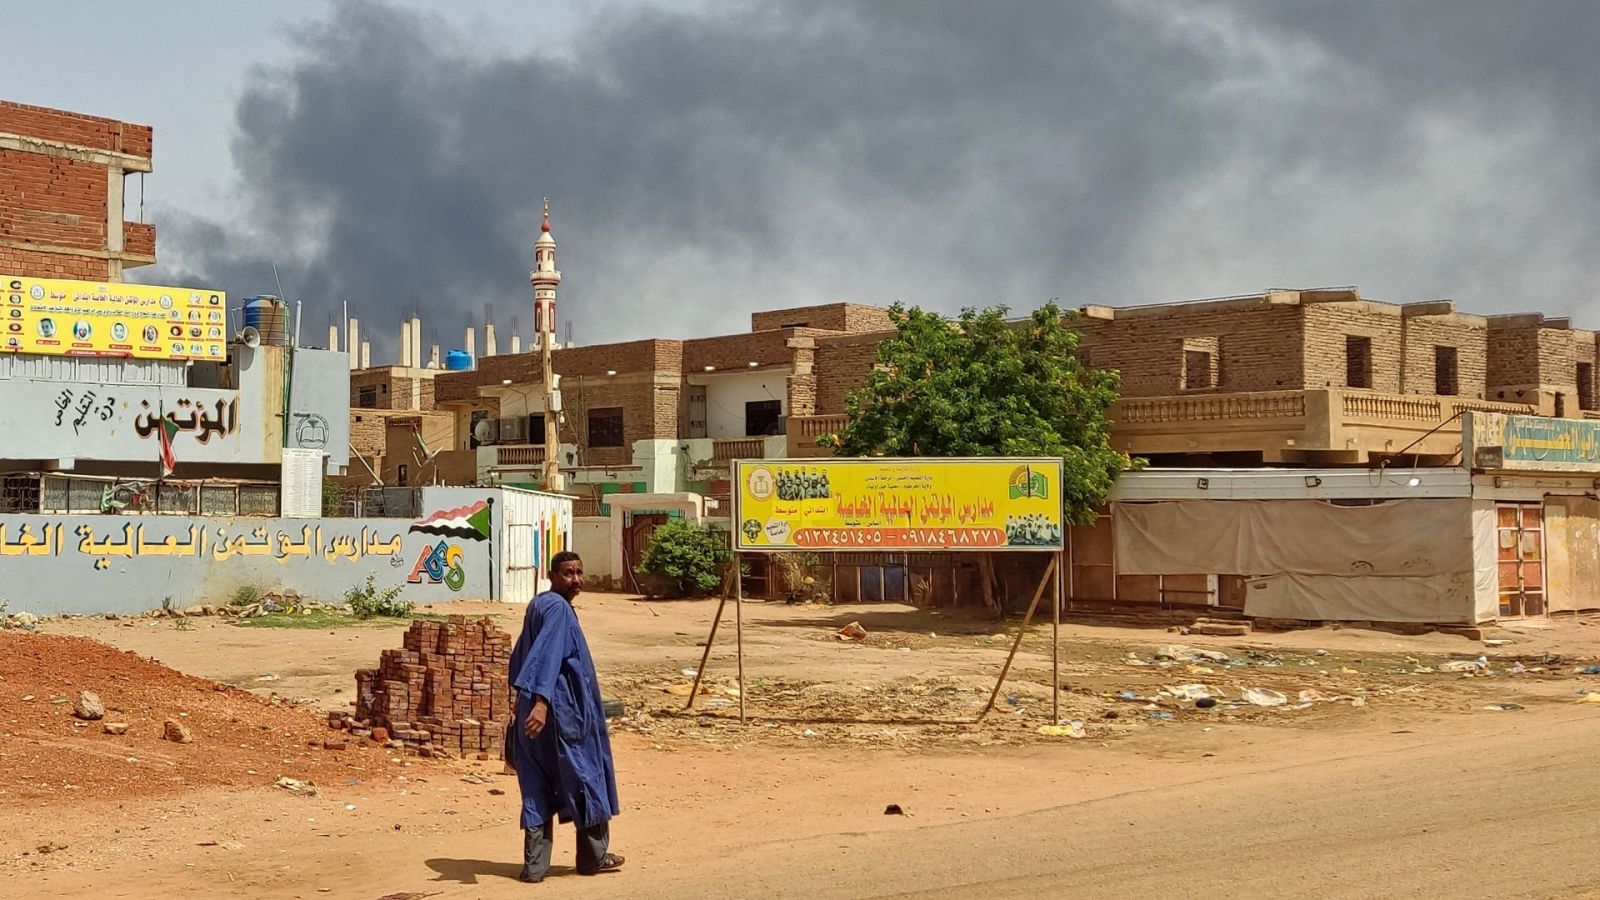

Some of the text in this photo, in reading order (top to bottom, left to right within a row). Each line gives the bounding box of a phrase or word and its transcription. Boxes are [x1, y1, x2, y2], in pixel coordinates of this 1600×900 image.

[134, 397, 238, 445] المؤتمن
[835, 492, 877, 519] الخاصة
[879, 491, 918, 526] العالمية
[958, 495, 995, 525] مدارس
[74, 521, 207, 571] العالمية
[211, 523, 322, 565] المؤتمن
[323, 524, 402, 564] مدارس
[902, 529, 999, 544] ٠٩١٨٤٦٨٢٧١
